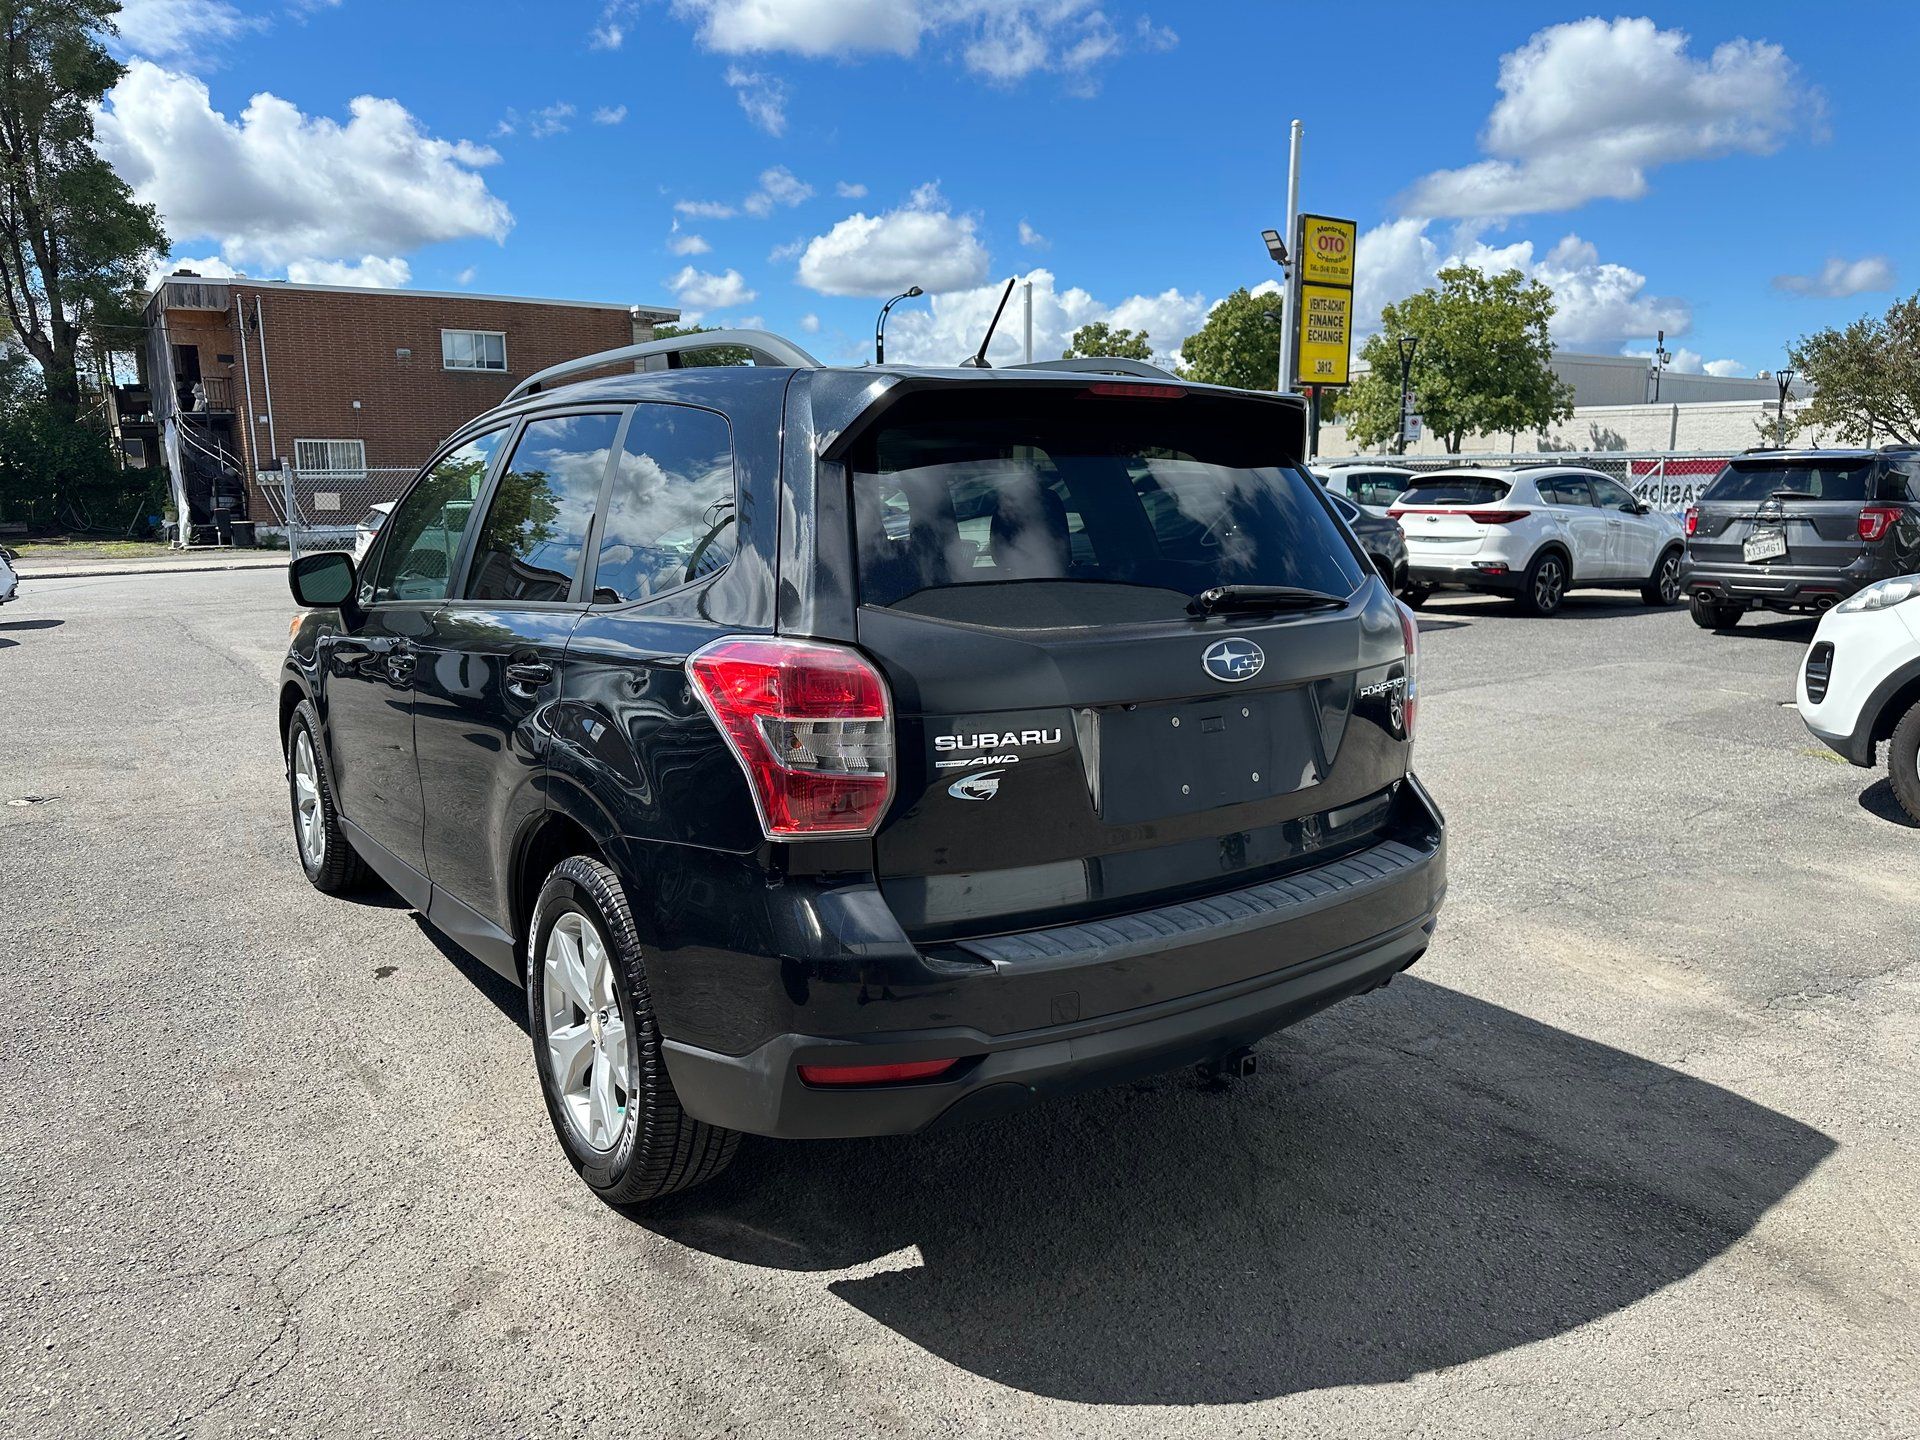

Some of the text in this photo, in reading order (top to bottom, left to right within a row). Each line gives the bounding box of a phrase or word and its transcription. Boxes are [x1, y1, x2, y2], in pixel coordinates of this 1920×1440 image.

[1318, 235, 1345, 253] OTO
[1309, 298, 1346, 312] VENTE-ACHAT
[1308, 314, 1344, 327] FINANCE
[1307, 329, 1344, 343] ECHANGE
[1317, 360, 1333, 373] 3812
[1360, 677, 1407, 699] FORESTER
[934, 728, 1062, 752] SUBARU
[968, 754, 1020, 766] AWD
